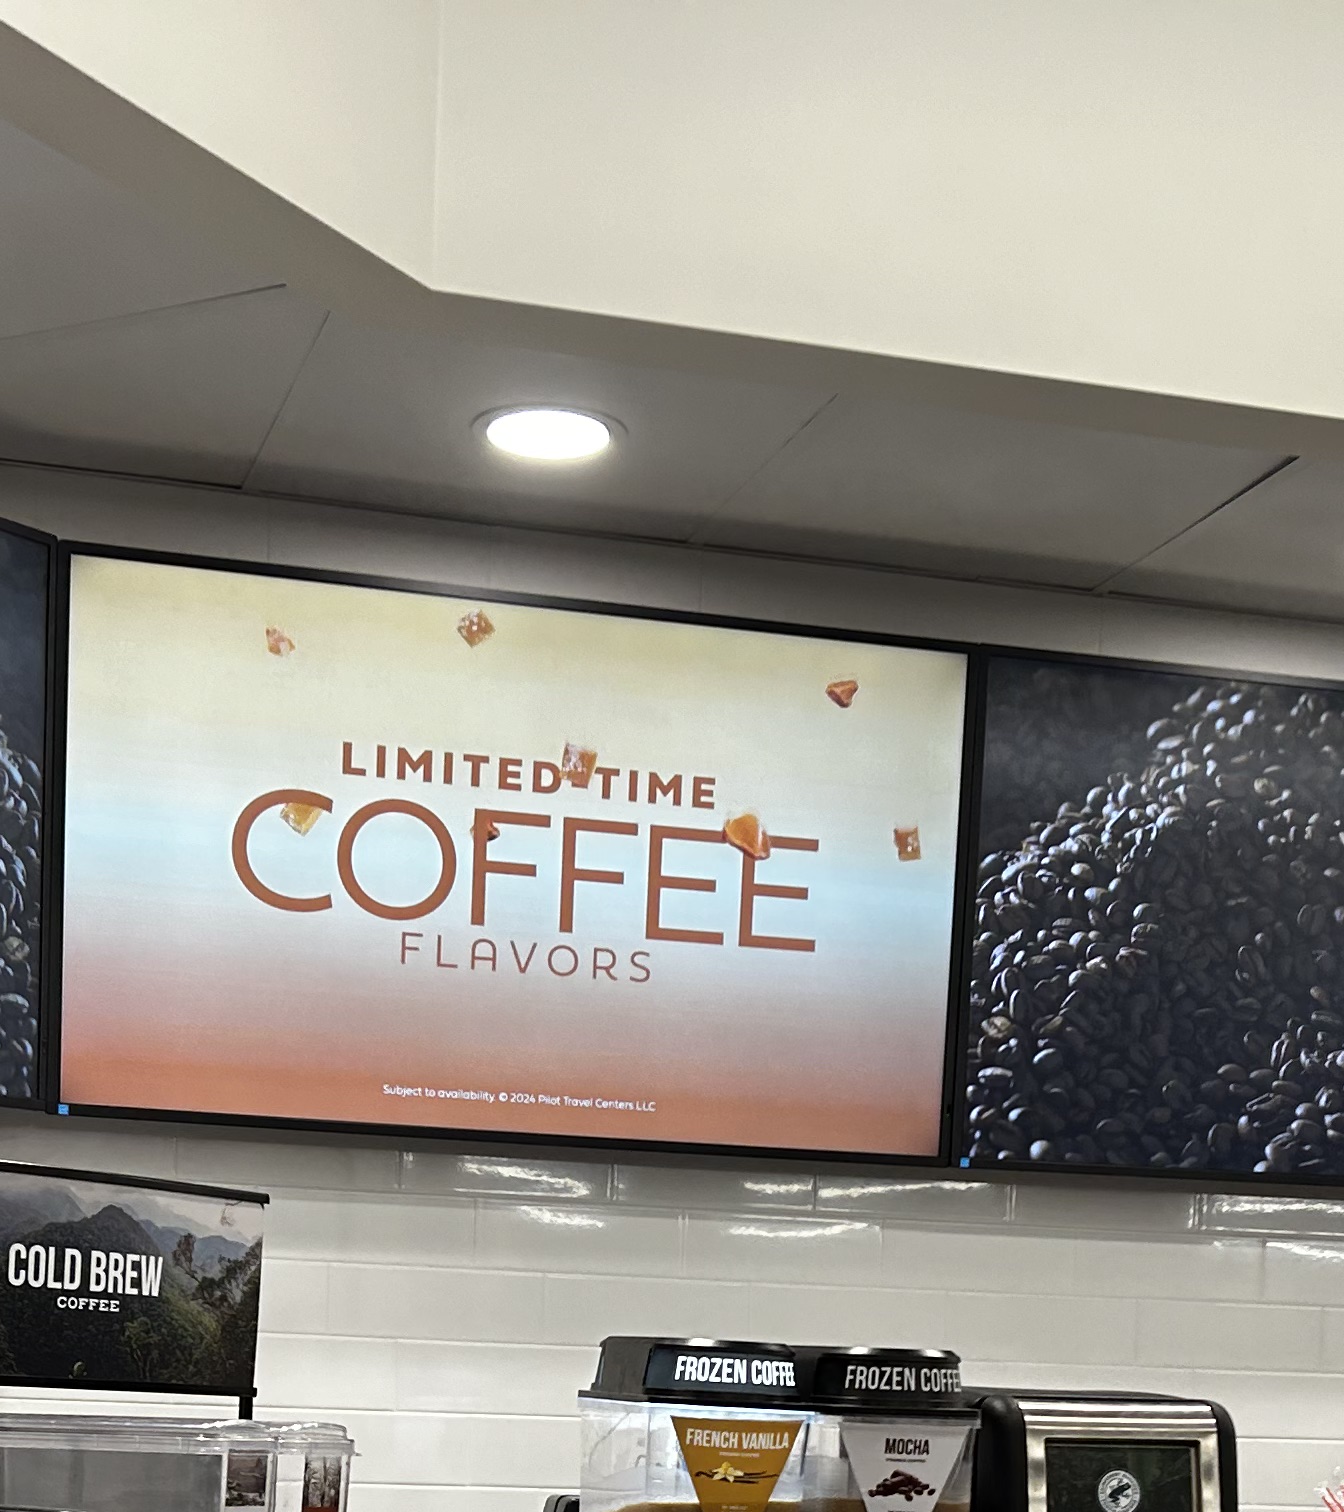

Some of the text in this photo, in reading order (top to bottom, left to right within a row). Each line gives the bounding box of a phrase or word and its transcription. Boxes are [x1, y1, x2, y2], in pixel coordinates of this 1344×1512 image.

[342, 741, 716, 810] LIMITED TIME
[231, 788, 820, 953] COFFEE
[401, 932, 652, 983] FLAVORS
[383, 1084, 422, 1097] Subject
[424, 1088, 436, 1098] to
[538, 1094, 561, 1106] Pilot
[564, 1096, 593, 1108] Travel
[595, 1098, 634, 1110] Centers
[635, 1101, 656, 1112] LLC
[8, 1243, 164, 1297] COLD BREW
[56, 1296, 120, 1313] COFFEE
[674, 1355, 747, 1384] FROZEN
[845, 1365, 916, 1392] FROZEN
[685, 1428, 789, 1450] FRENCH VANILLA
[884, 1438, 930, 1456] MOCHA
